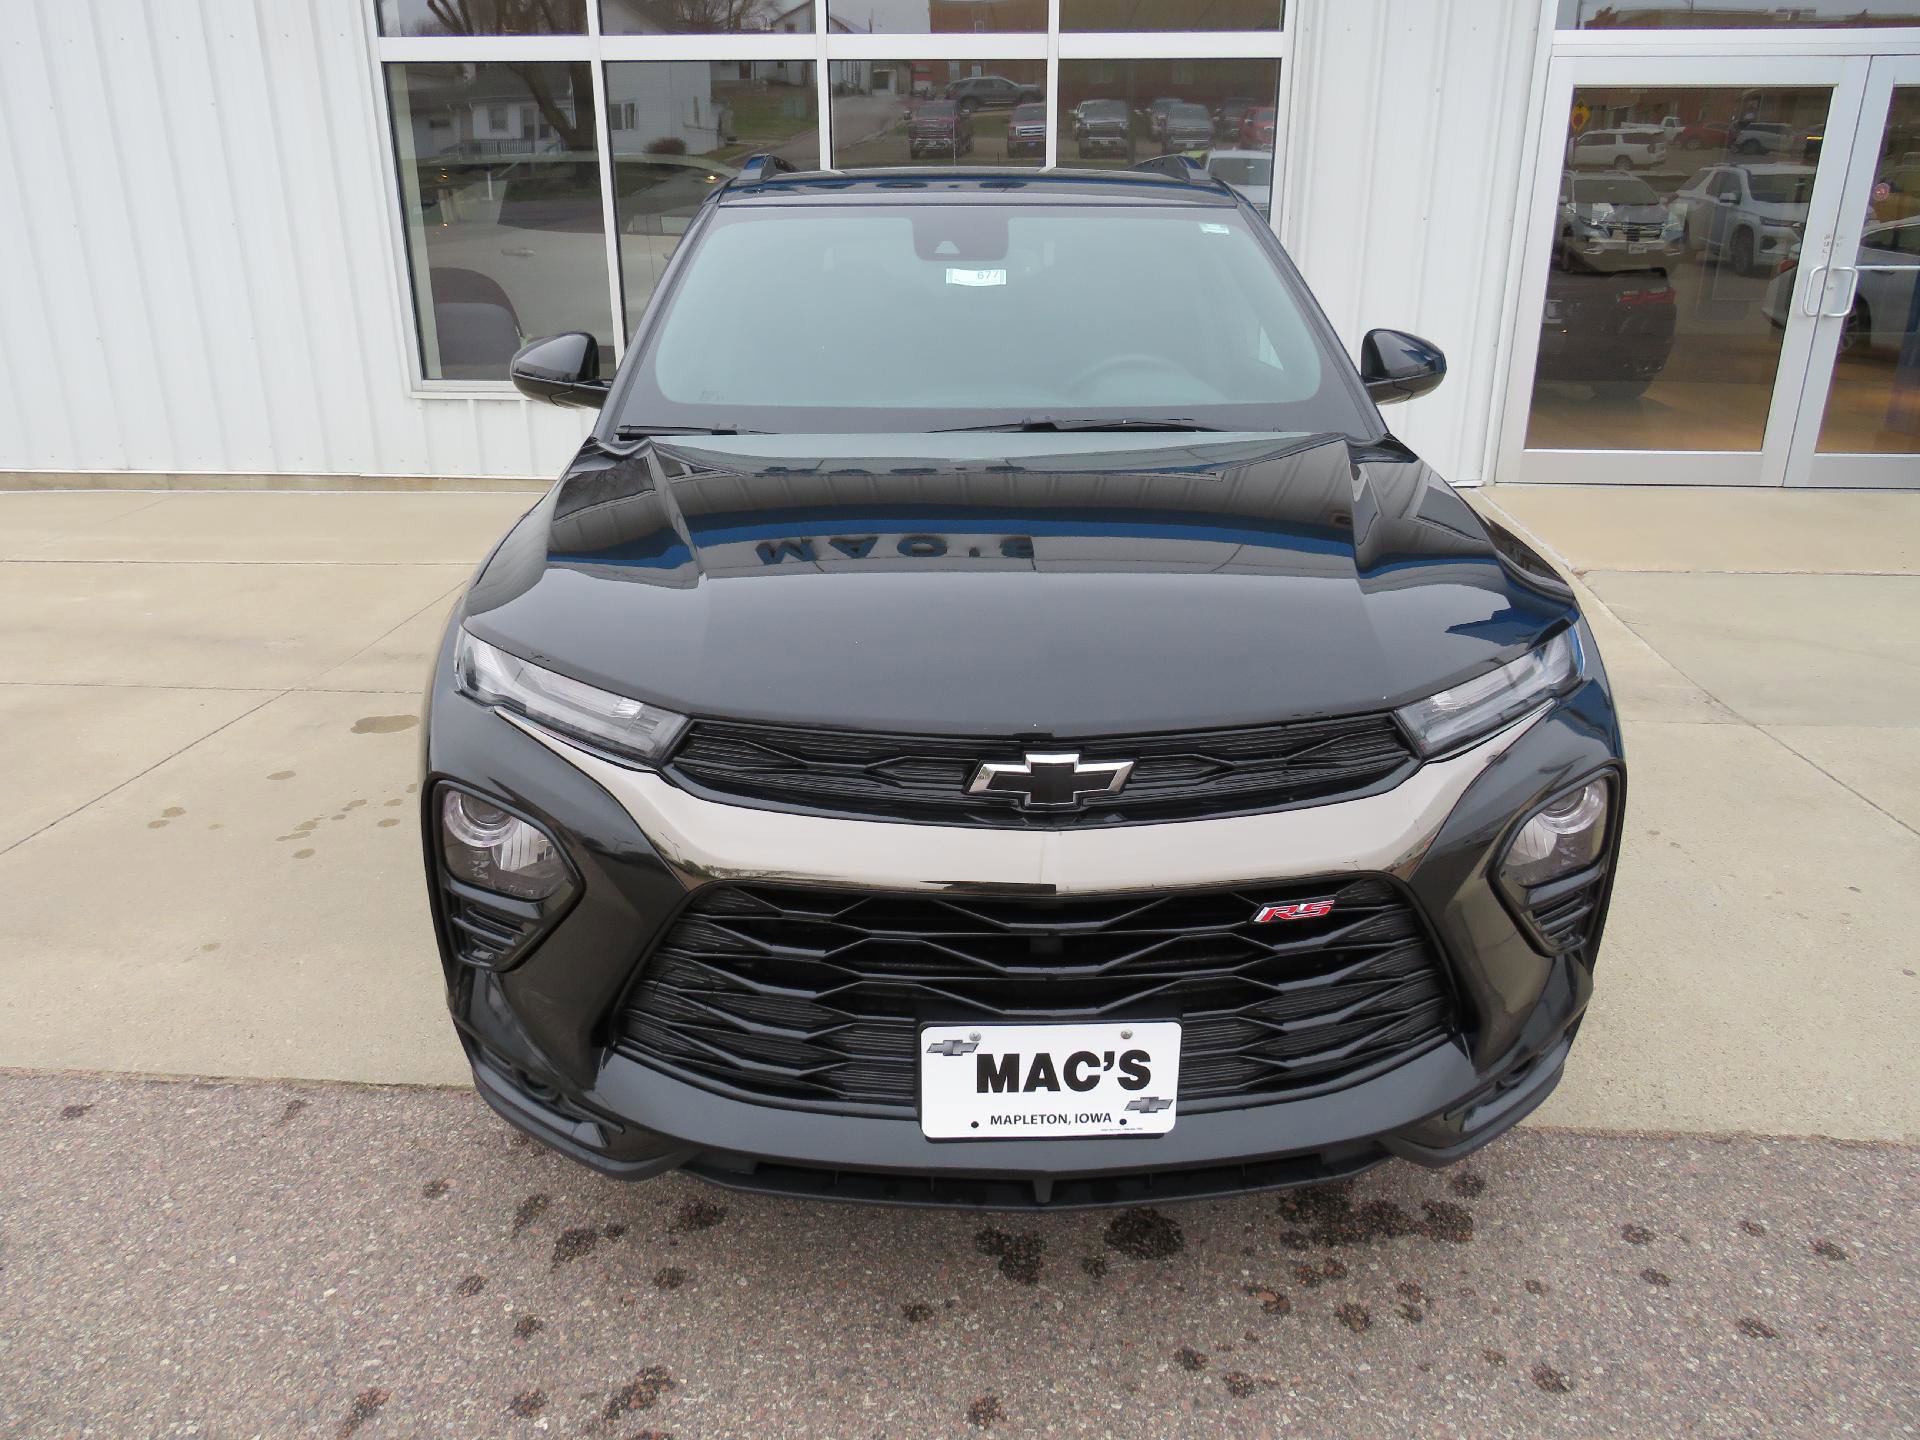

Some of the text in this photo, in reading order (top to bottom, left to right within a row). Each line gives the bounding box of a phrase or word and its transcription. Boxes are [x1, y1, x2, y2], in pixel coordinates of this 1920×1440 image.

[1253, 899, 1335, 922] RS
[976, 1049, 1151, 1094] MAC'S
[990, 1112, 1112, 1127] MAPLETON, IOWA
